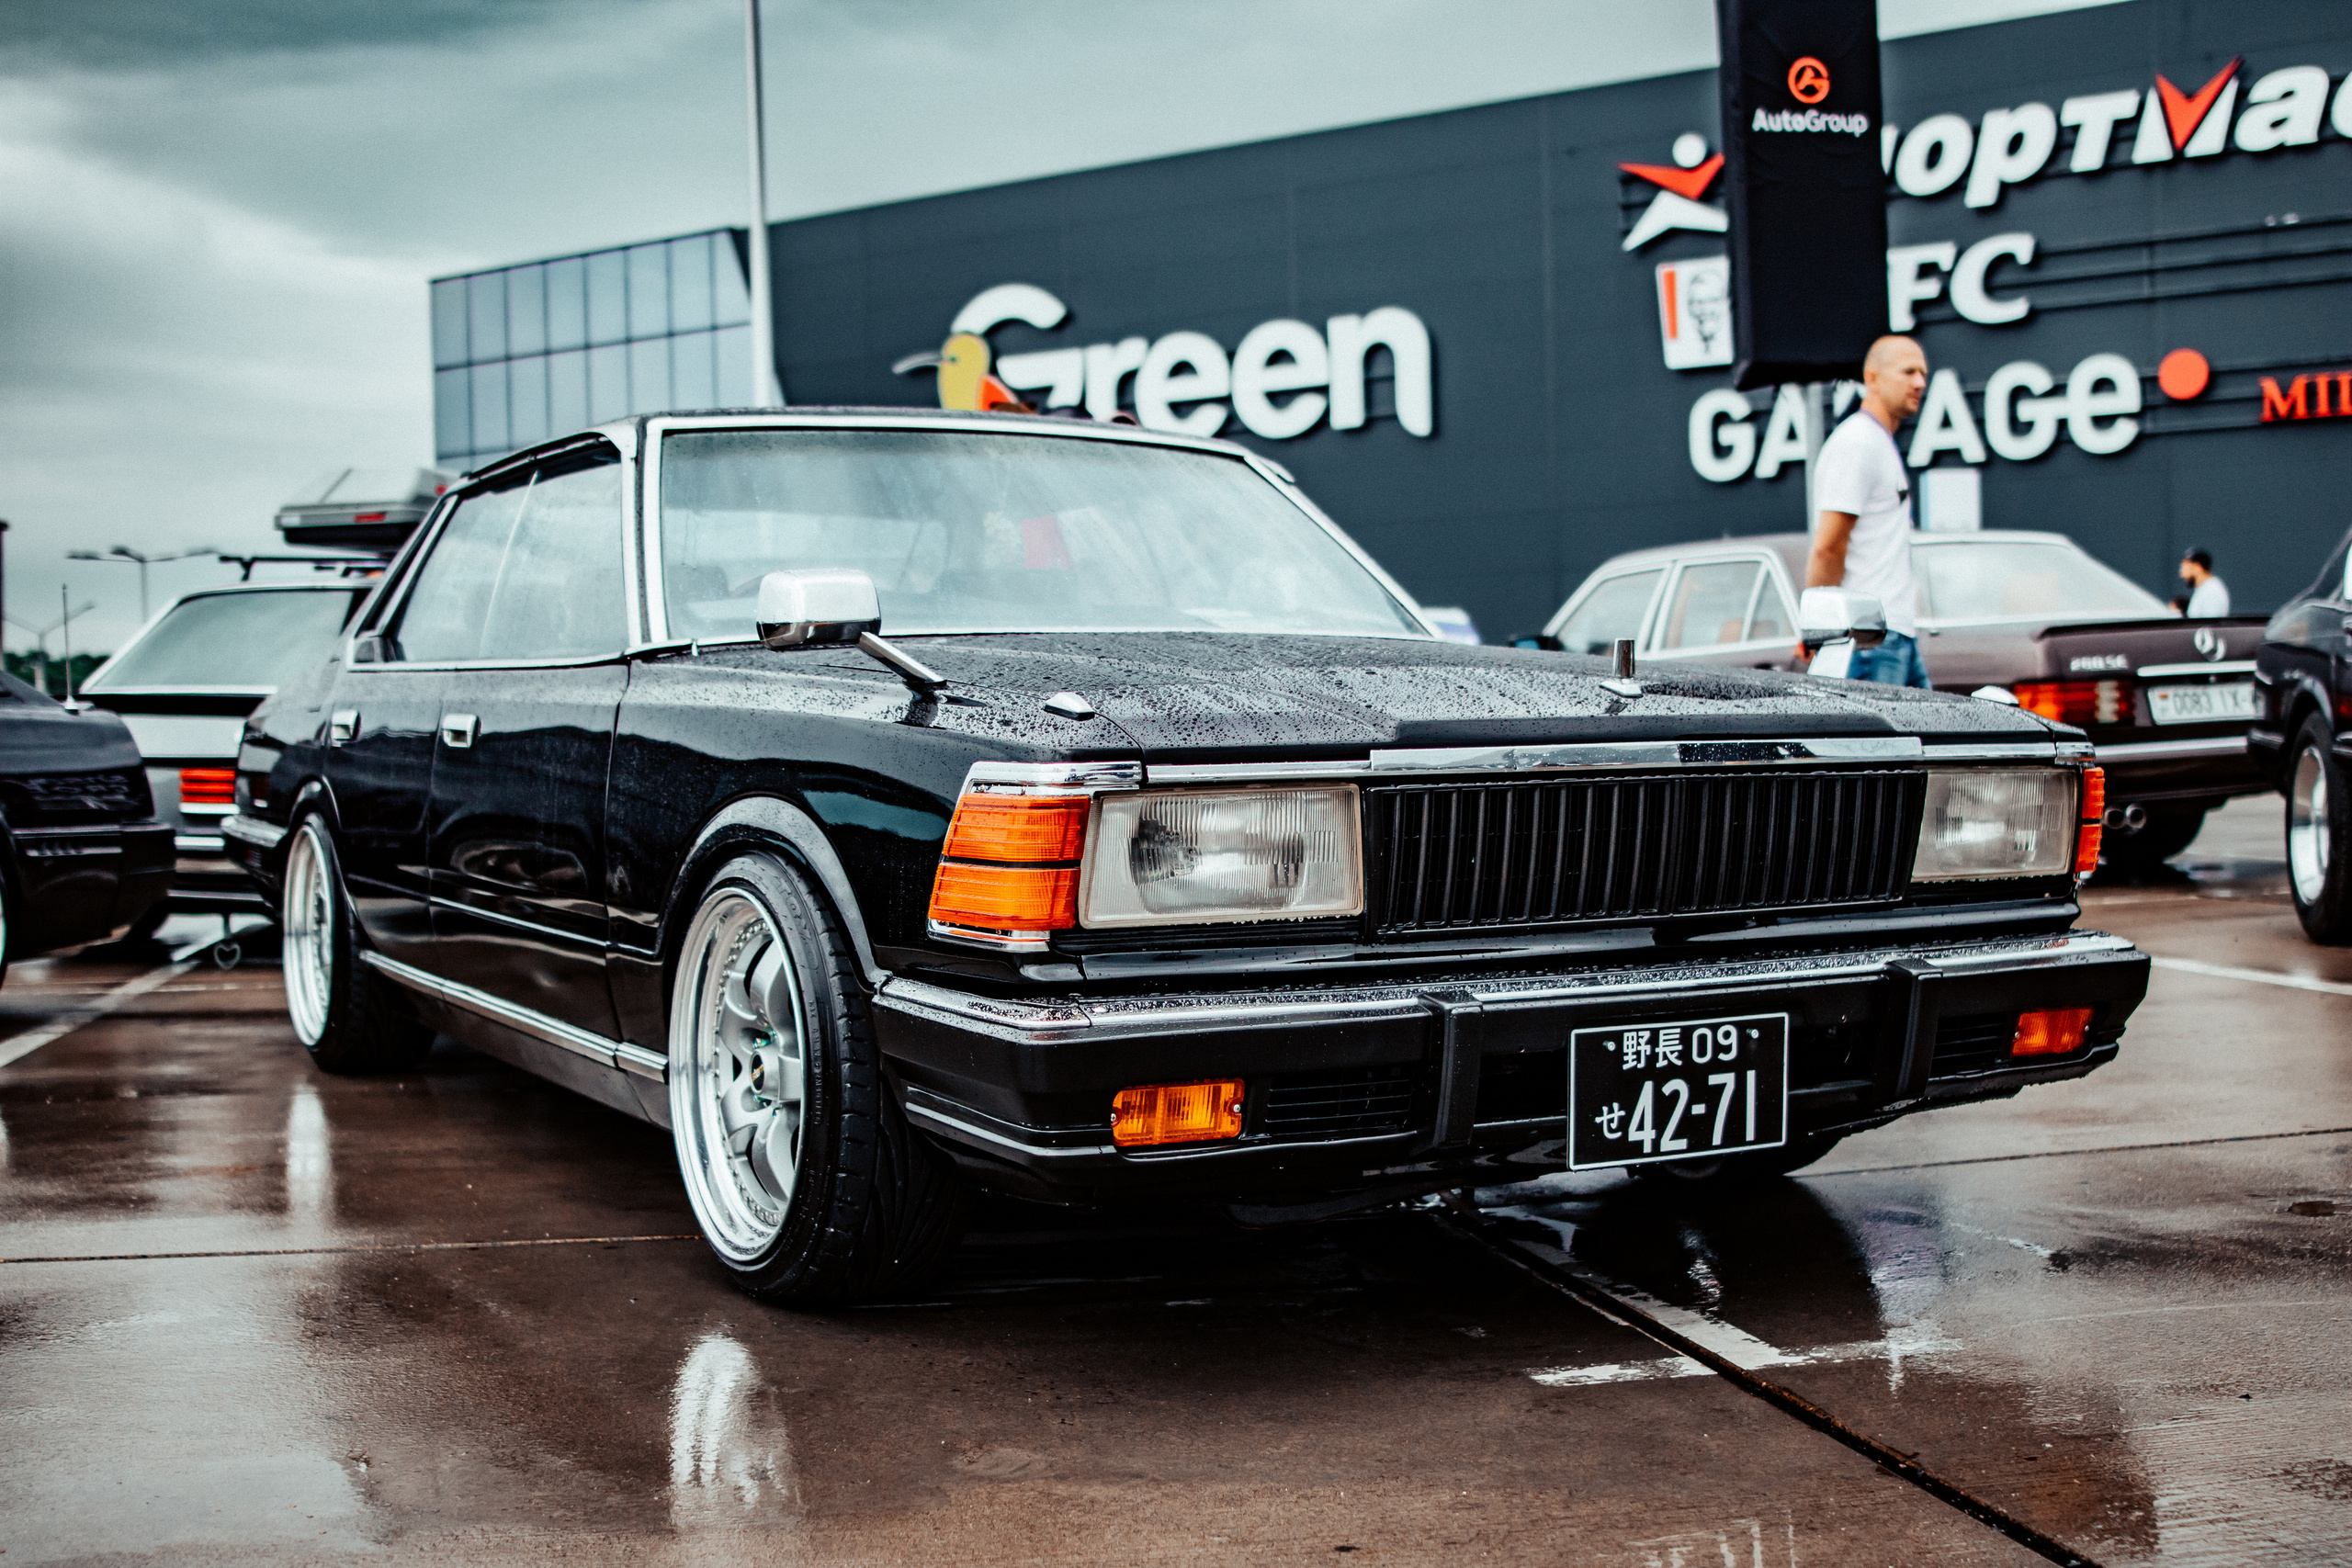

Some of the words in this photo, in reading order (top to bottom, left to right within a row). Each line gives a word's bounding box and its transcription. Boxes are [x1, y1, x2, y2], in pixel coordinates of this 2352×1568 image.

[1752, 107, 1869, 138] AutoGroup
[1886, 232, 2036, 333] FC
[950, 283, 1432, 439] Green
[1623, 1027, 1683, 1070] 野長
[1692, 1024, 1738, 1065] 09
[1594, 1101, 1626, 1140] せ
[1627, 1069, 1757, 1154] 42-71
